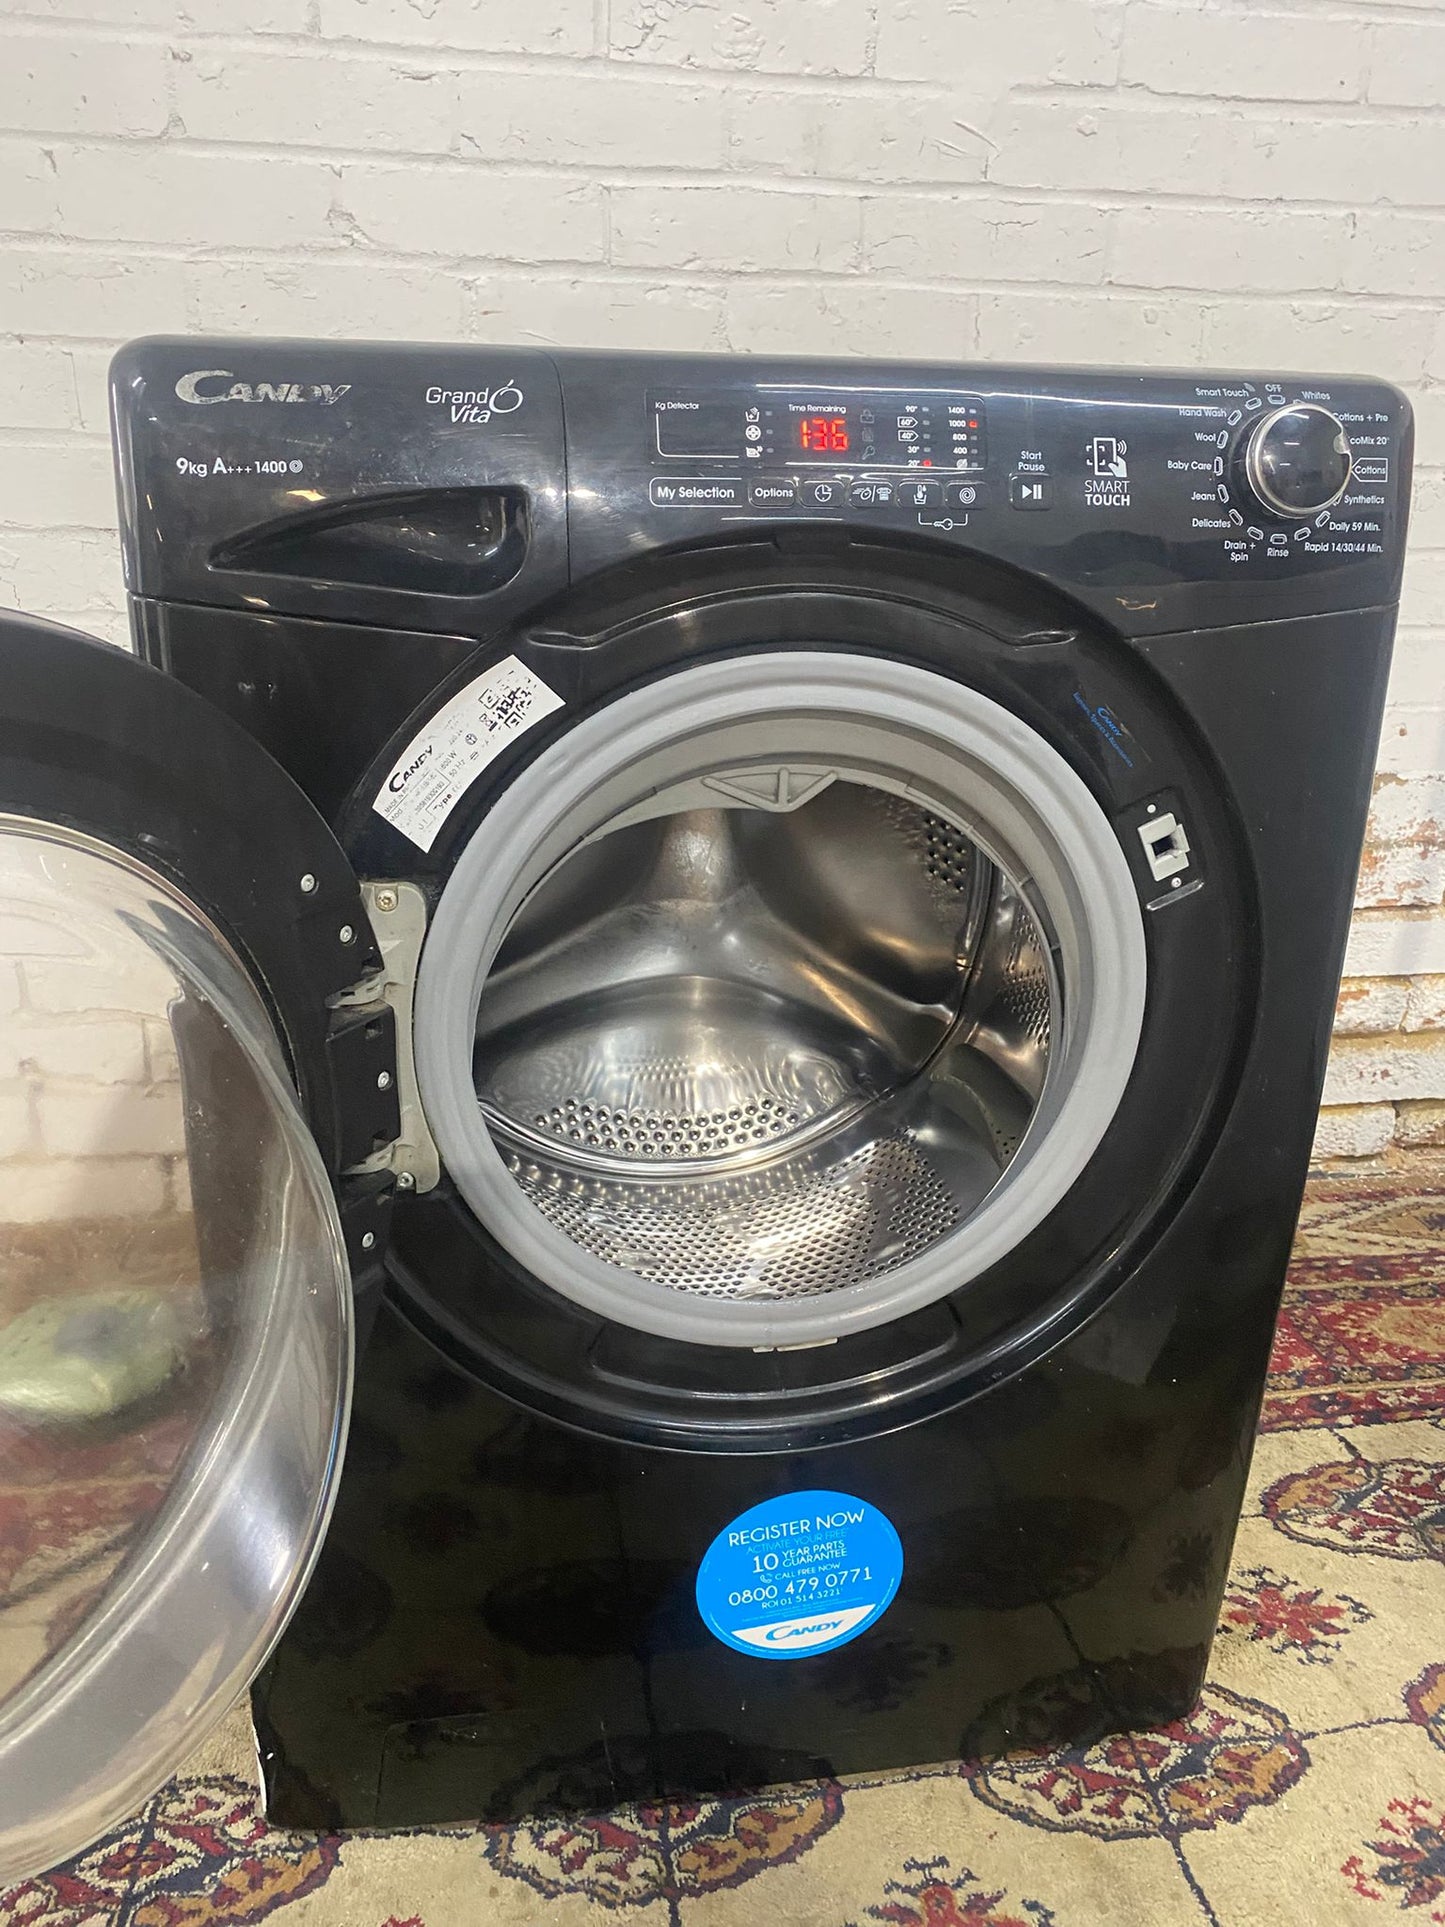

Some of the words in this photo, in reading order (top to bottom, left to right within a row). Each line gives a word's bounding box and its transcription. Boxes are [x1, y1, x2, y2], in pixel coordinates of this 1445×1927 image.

[175, 369, 352, 405] CANDY
[1195, 387, 1221, 397] Smart
[1222, 388, 1249, 397] Touch
[1265, 384, 1282, 393] OFF
[1301, 391, 1331, 400] Whites
[655, 401, 666, 411] Kg
[667, 401, 700, 410] Detector
[788, 404, 806, 412] Time
[807, 405, 847, 415] Remaining
[948, 406, 966, 414] 1400
[451, 404, 491, 423] Vita
[1179, 408, 1203, 417] Hand
[1203, 408, 1227, 418] Wash
[1375, 413, 1389, 422] Pre
[952, 433, 968, 441] 800
[1195, 432, 1217, 442] Wool
[1348, 436, 1375, 445] coMix
[953, 447, 968, 455] 400
[1020, 450, 1042, 460] Start
[175, 457, 208, 477] 9kg
[212, 457, 252, 474] A+++
[254, 460, 287, 474] 1400
[1018, 461, 1046, 472] Pause
[1167, 460, 1189, 471] Baby
[1191, 461, 1212, 471] Care
[1354, 466, 1386, 475] Cottons
[1084, 480, 1131, 493] SMART
[657, 487, 677, 499] My
[678, 486, 735, 498] Selection
[754, 487, 794, 499] Options
[1191, 491, 1216, 501] Jeans
[1085, 494, 1131, 507] TOUCH
[1344, 494, 1385, 506] Synthetics
[1192, 518, 1231, 528] Delicates
[1329, 521, 1350, 533] Daily
[1351, 522, 1362, 531] 59
[1364, 522, 1381, 531] Min.
[1224, 541, 1247, 550] Drain
[1304, 542, 1329, 553] Rapid
[1367, 543, 1384, 553] Min.
[1230, 552, 1249, 563] Spin
[1267, 547, 1289, 557] Rinse
[1097, 707, 1122, 736] CANDY
[388, 745, 433, 793] CANDY
[728, 1519, 811, 1547] REGISTER
[816, 1508, 865, 1531] NOW
[746, 1539, 792, 1554] ACTIVATE
[794, 1533, 824, 1546] YOUR
[752, 1553, 779, 1574] 10
[782, 1546, 810, 1559] YEAR
[813, 1540, 845, 1554] PARTS
[782, 1549, 848, 1568] GUARANTEE
[775, 1571, 796, 1581] CALL
[798, 1566, 816, 1576] FREE
[818, 1562, 841, 1572] NOW
[728, 1585, 778, 1606] 0800
[785, 1577, 819, 1595] 479
[825, 1566, 872, 1588] 0771
[762, 1600, 779, 1609] ROI
[780, 1597, 793, 1606] 01
[796, 1592, 814, 1603] 514
[765, 1620, 844, 1641] CANDY
